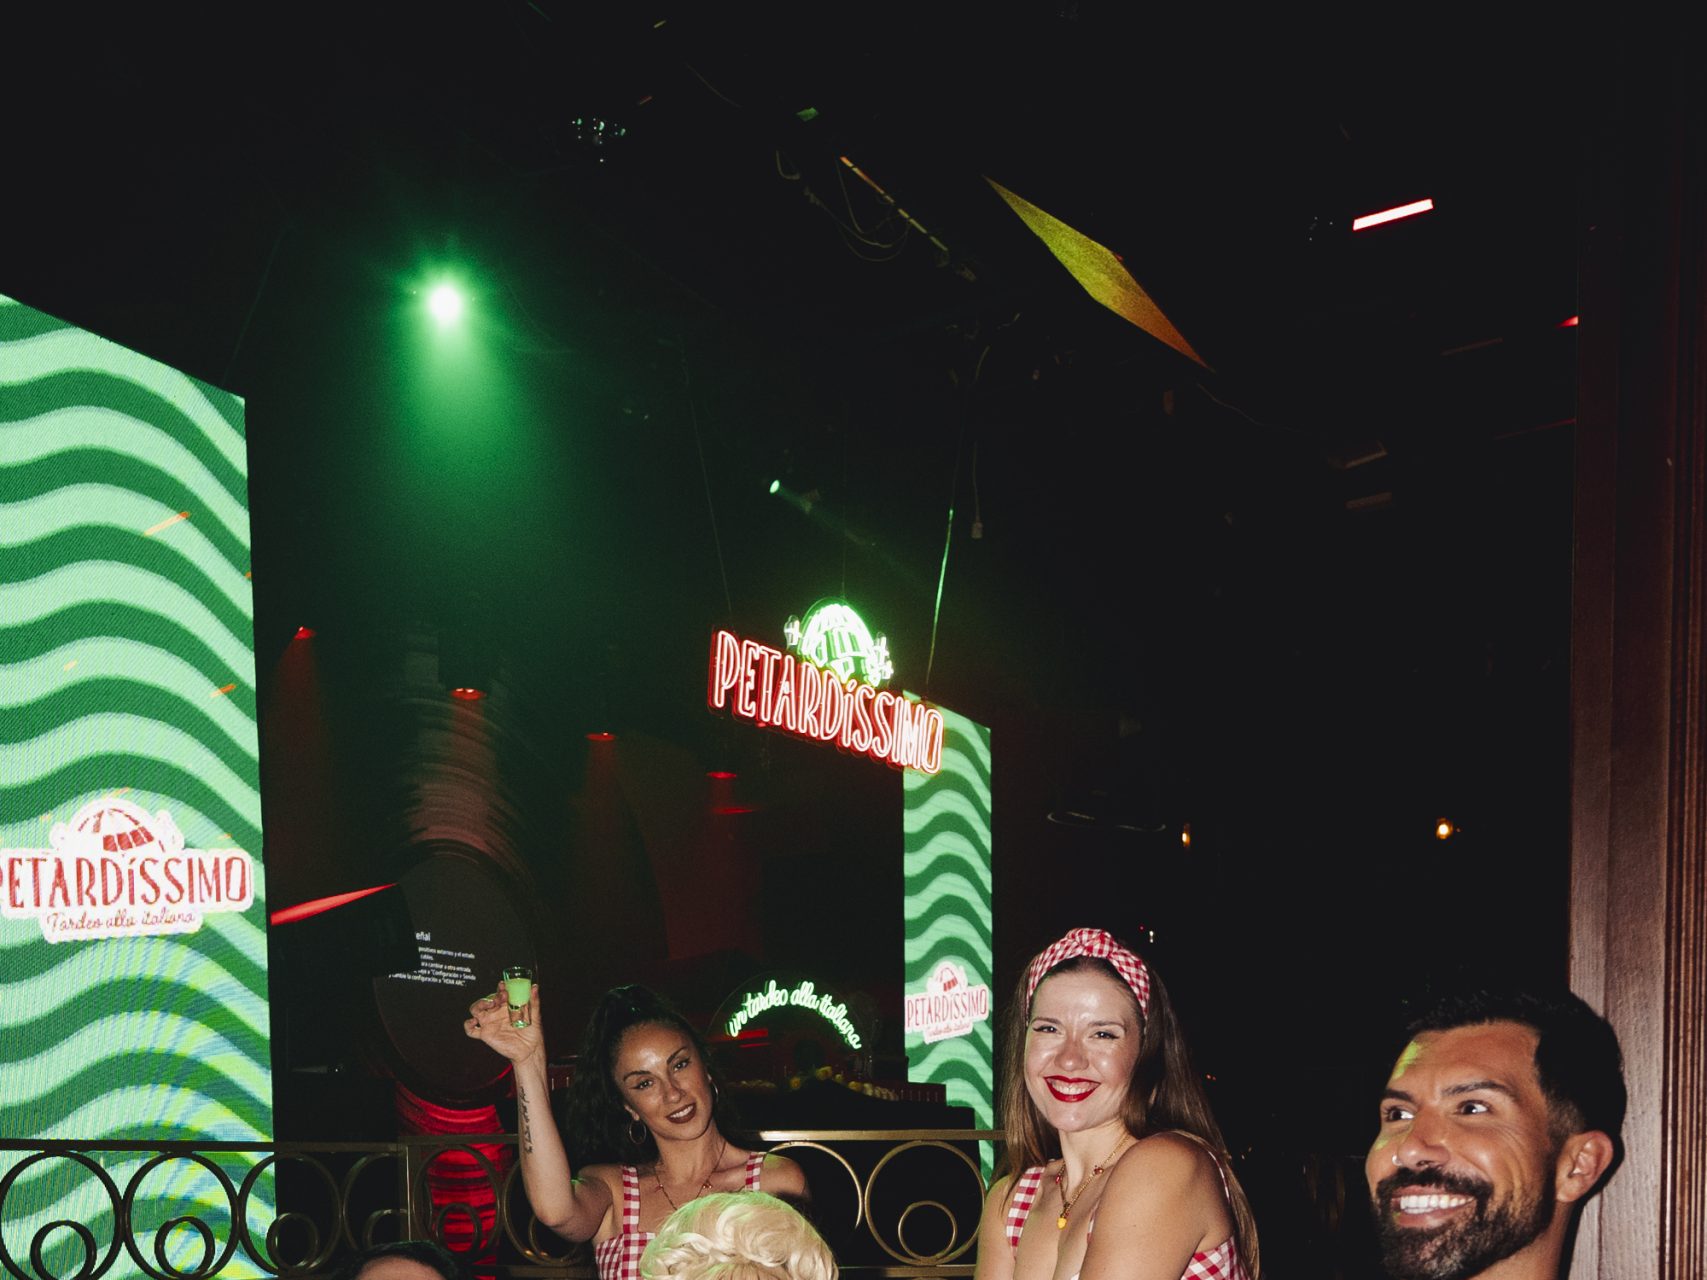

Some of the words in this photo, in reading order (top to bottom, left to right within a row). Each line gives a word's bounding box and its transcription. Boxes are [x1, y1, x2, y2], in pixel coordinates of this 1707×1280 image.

[0, 856, 247, 908] ETARDíSSIMO
[46, 911, 103, 932] Tardeo
[106, 908, 136, 928] alla
[141, 906, 195, 926] italiana
[728, 1009, 748, 1038] un
[741, 979, 788, 1019] tardeo
[790, 980, 820, 1009] alla
